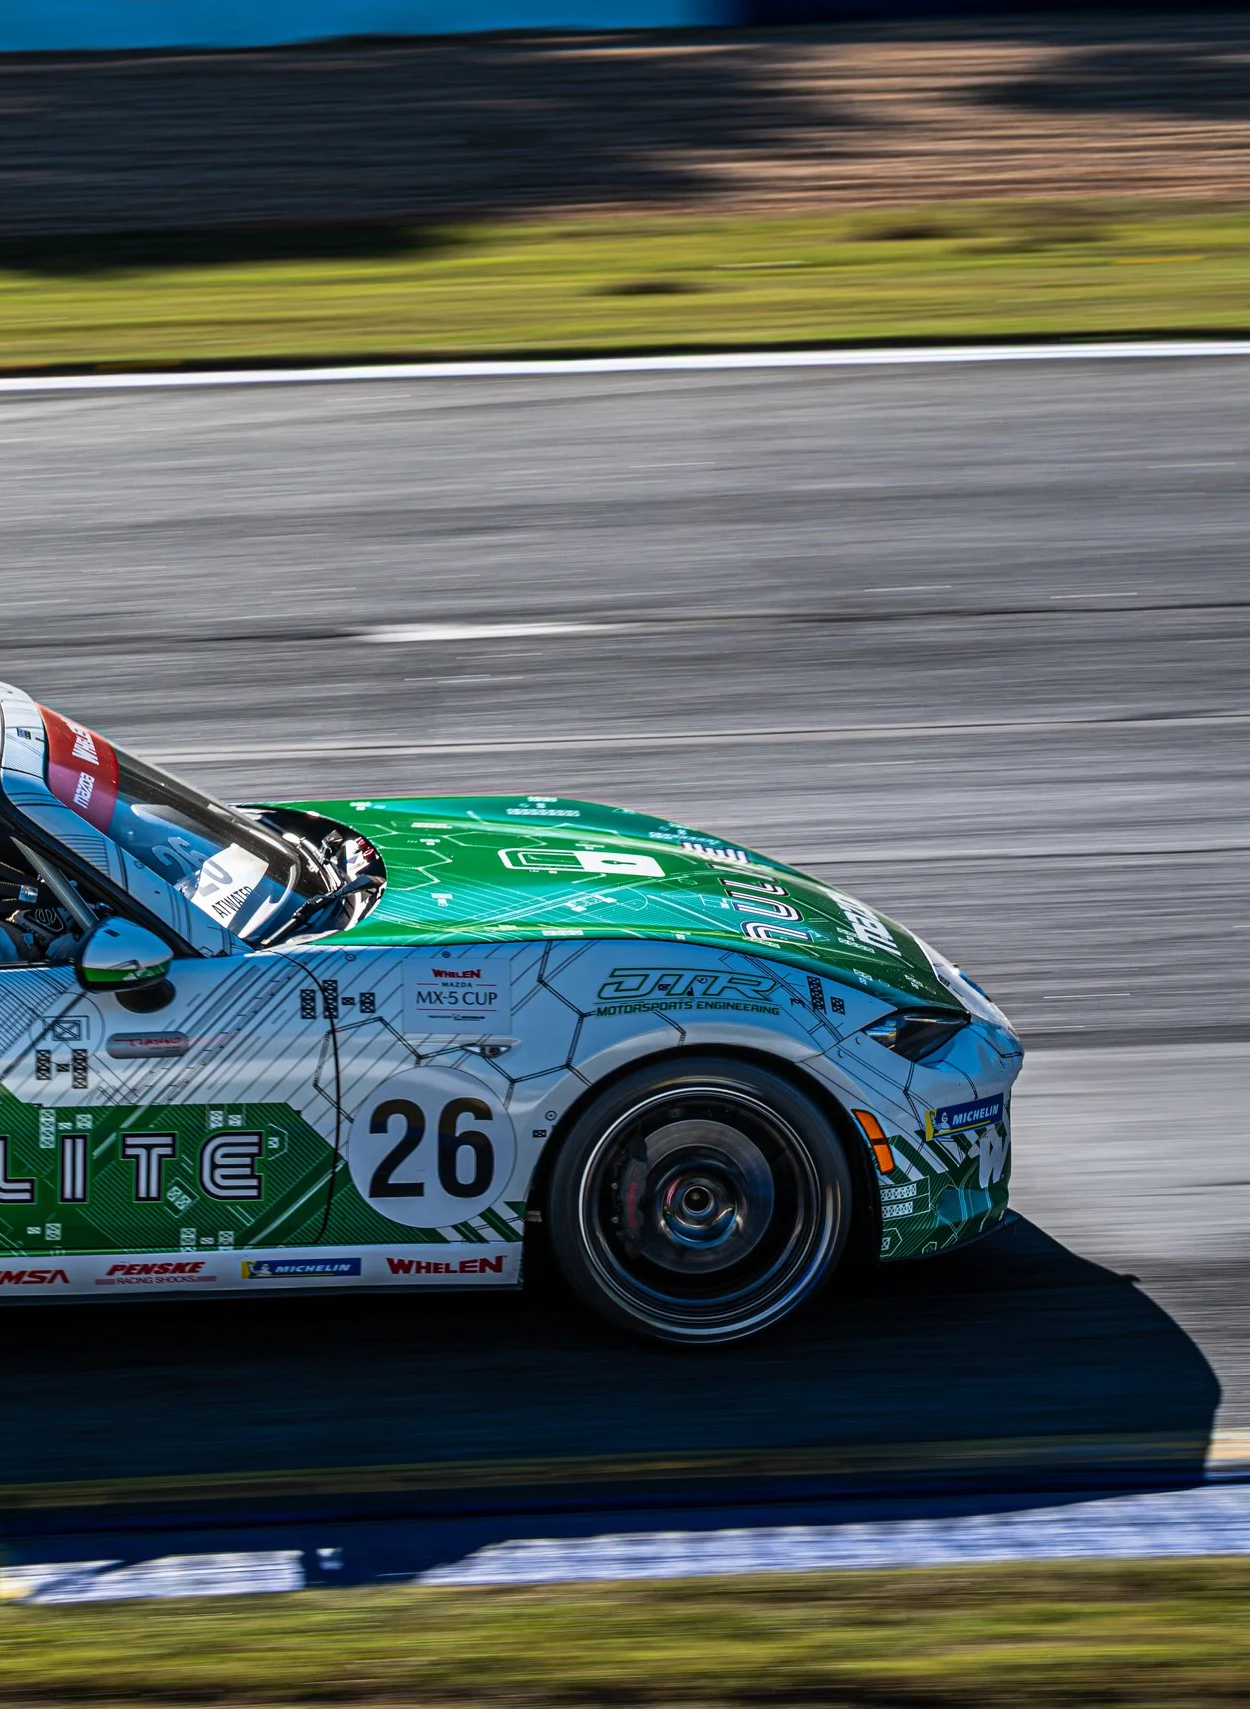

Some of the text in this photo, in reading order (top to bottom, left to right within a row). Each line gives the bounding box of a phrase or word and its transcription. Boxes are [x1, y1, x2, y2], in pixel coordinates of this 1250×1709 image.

[73, 772, 95, 809] mazda
[431, 968, 482, 978] WHELEN
[598, 967, 778, 1001] JTR
[416, 991, 498, 1006] MX-5 CUP
[596, 1001, 780, 1017] MOTORSPORTS ENGINEERING
[952, 1103, 1000, 1126] MICHELIN
[368, 1097, 495, 1198] 26
[106, 1262, 206, 1275] PENSKE
[274, 1263, 351, 1273] MICHELIN
[386, 1256, 504, 1274] WHELEN
[116, 1277, 153, 1285] RACING
